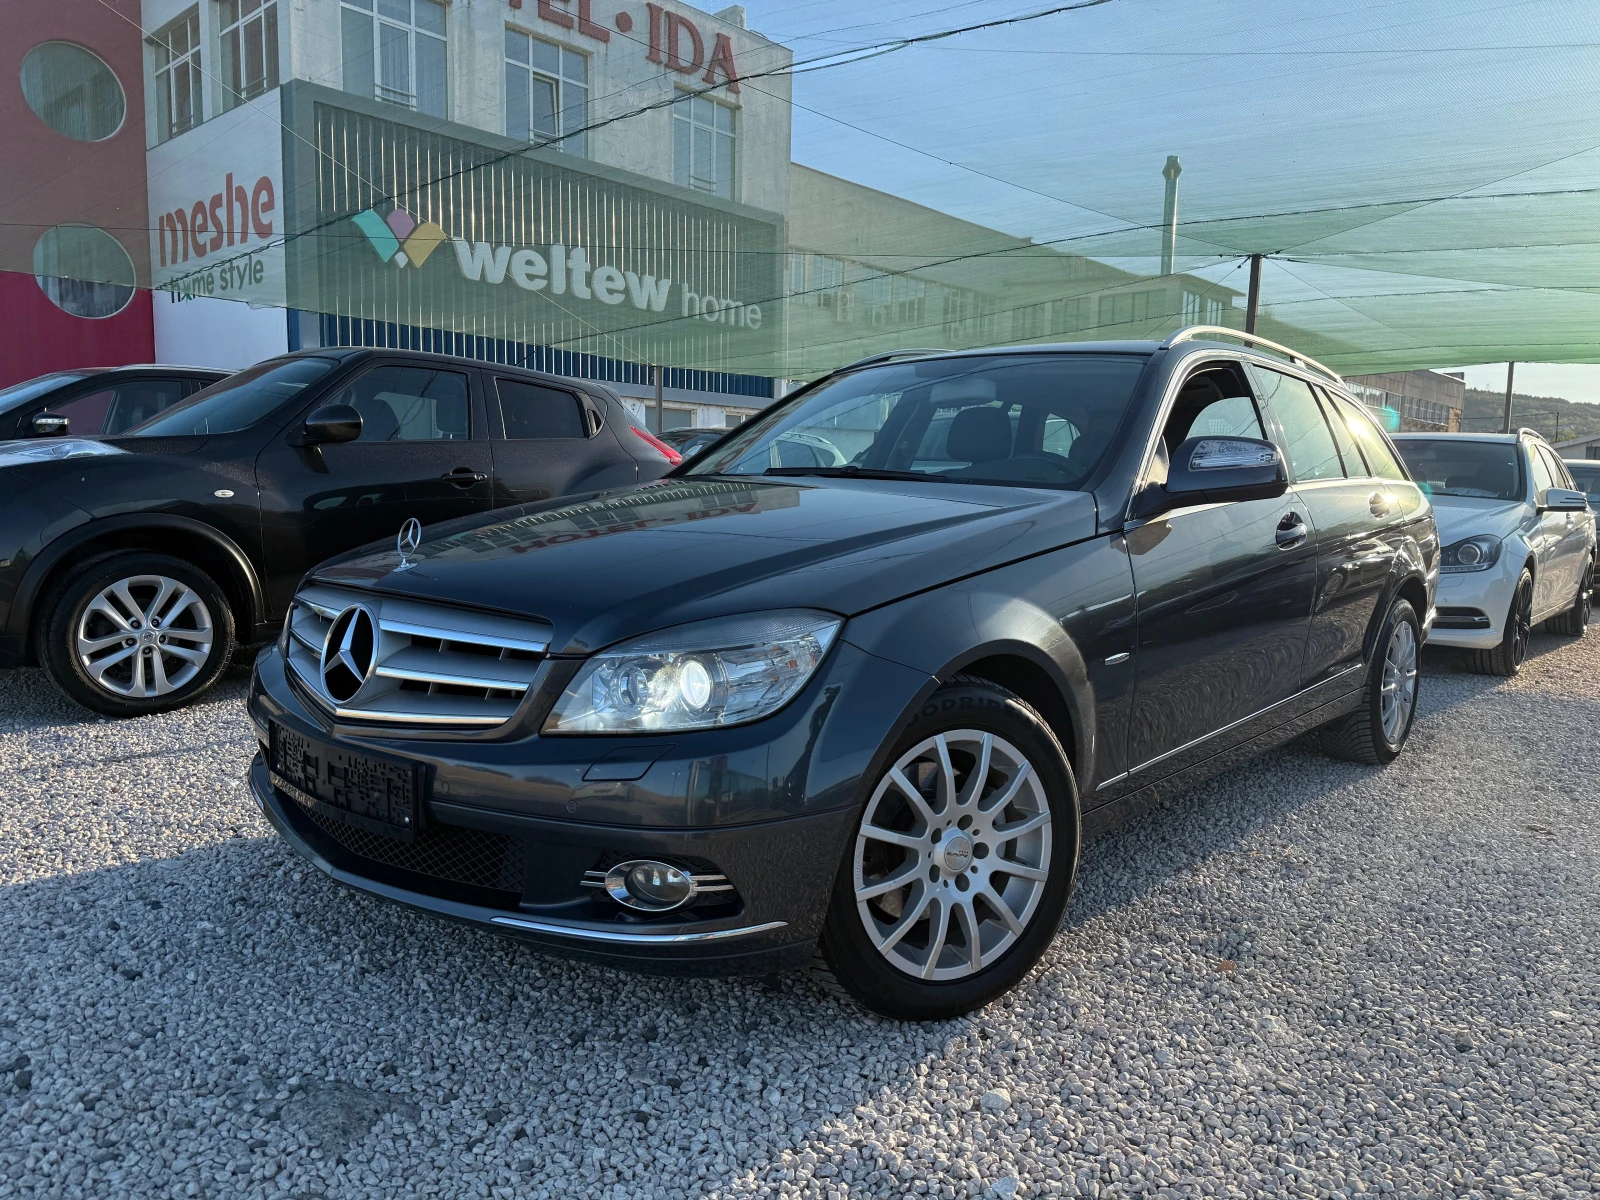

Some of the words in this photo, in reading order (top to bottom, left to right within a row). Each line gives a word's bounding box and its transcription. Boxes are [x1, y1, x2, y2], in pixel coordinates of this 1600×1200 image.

[646, 2, 741, 94] IDA
[159, 172, 275, 267] meshe
[220, 253, 264, 291] style
[453, 236, 671, 312] weltew
[682, 283, 762, 329] home
